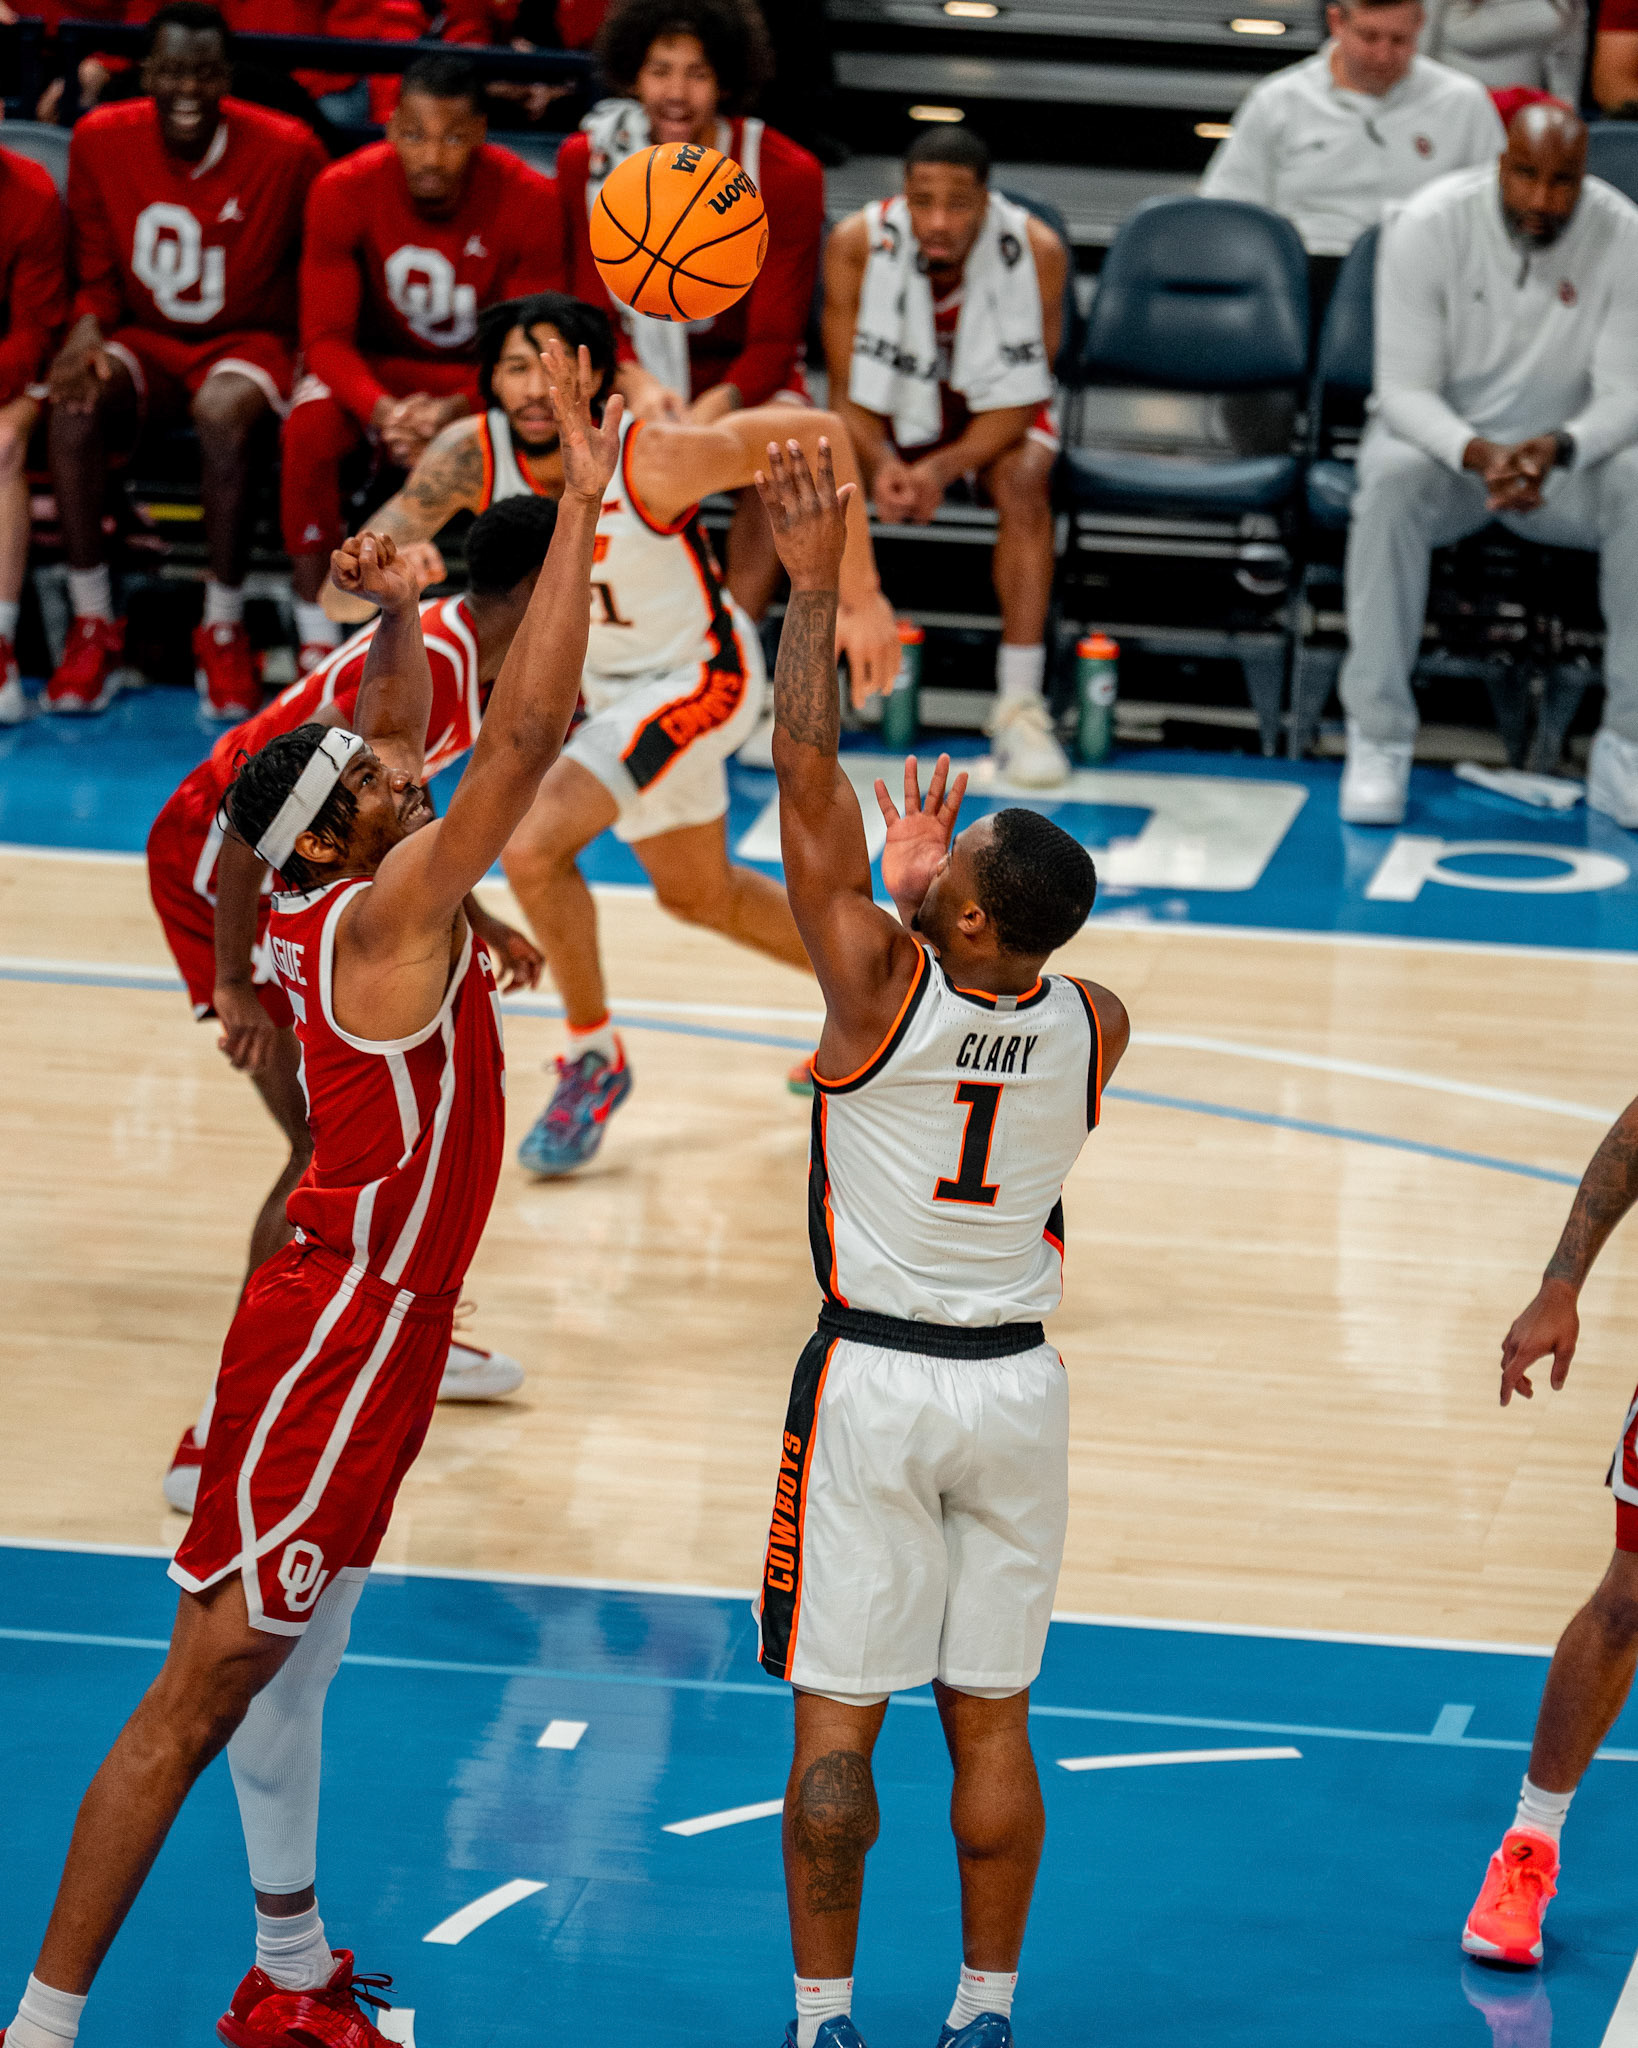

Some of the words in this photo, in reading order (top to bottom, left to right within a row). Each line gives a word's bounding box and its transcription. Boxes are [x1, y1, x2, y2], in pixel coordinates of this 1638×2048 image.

[671, 144, 707, 173] CAA
[132, 202, 226, 324] OU
[384, 244, 477, 347] OU
[271, 936, 307, 986] GUE
[956, 1033, 1039, 1074] CLARY
[933, 1080, 1004, 1207] 1
[767, 1430, 801, 1593] COWBOYS
[277, 1539, 330, 1612] OU
